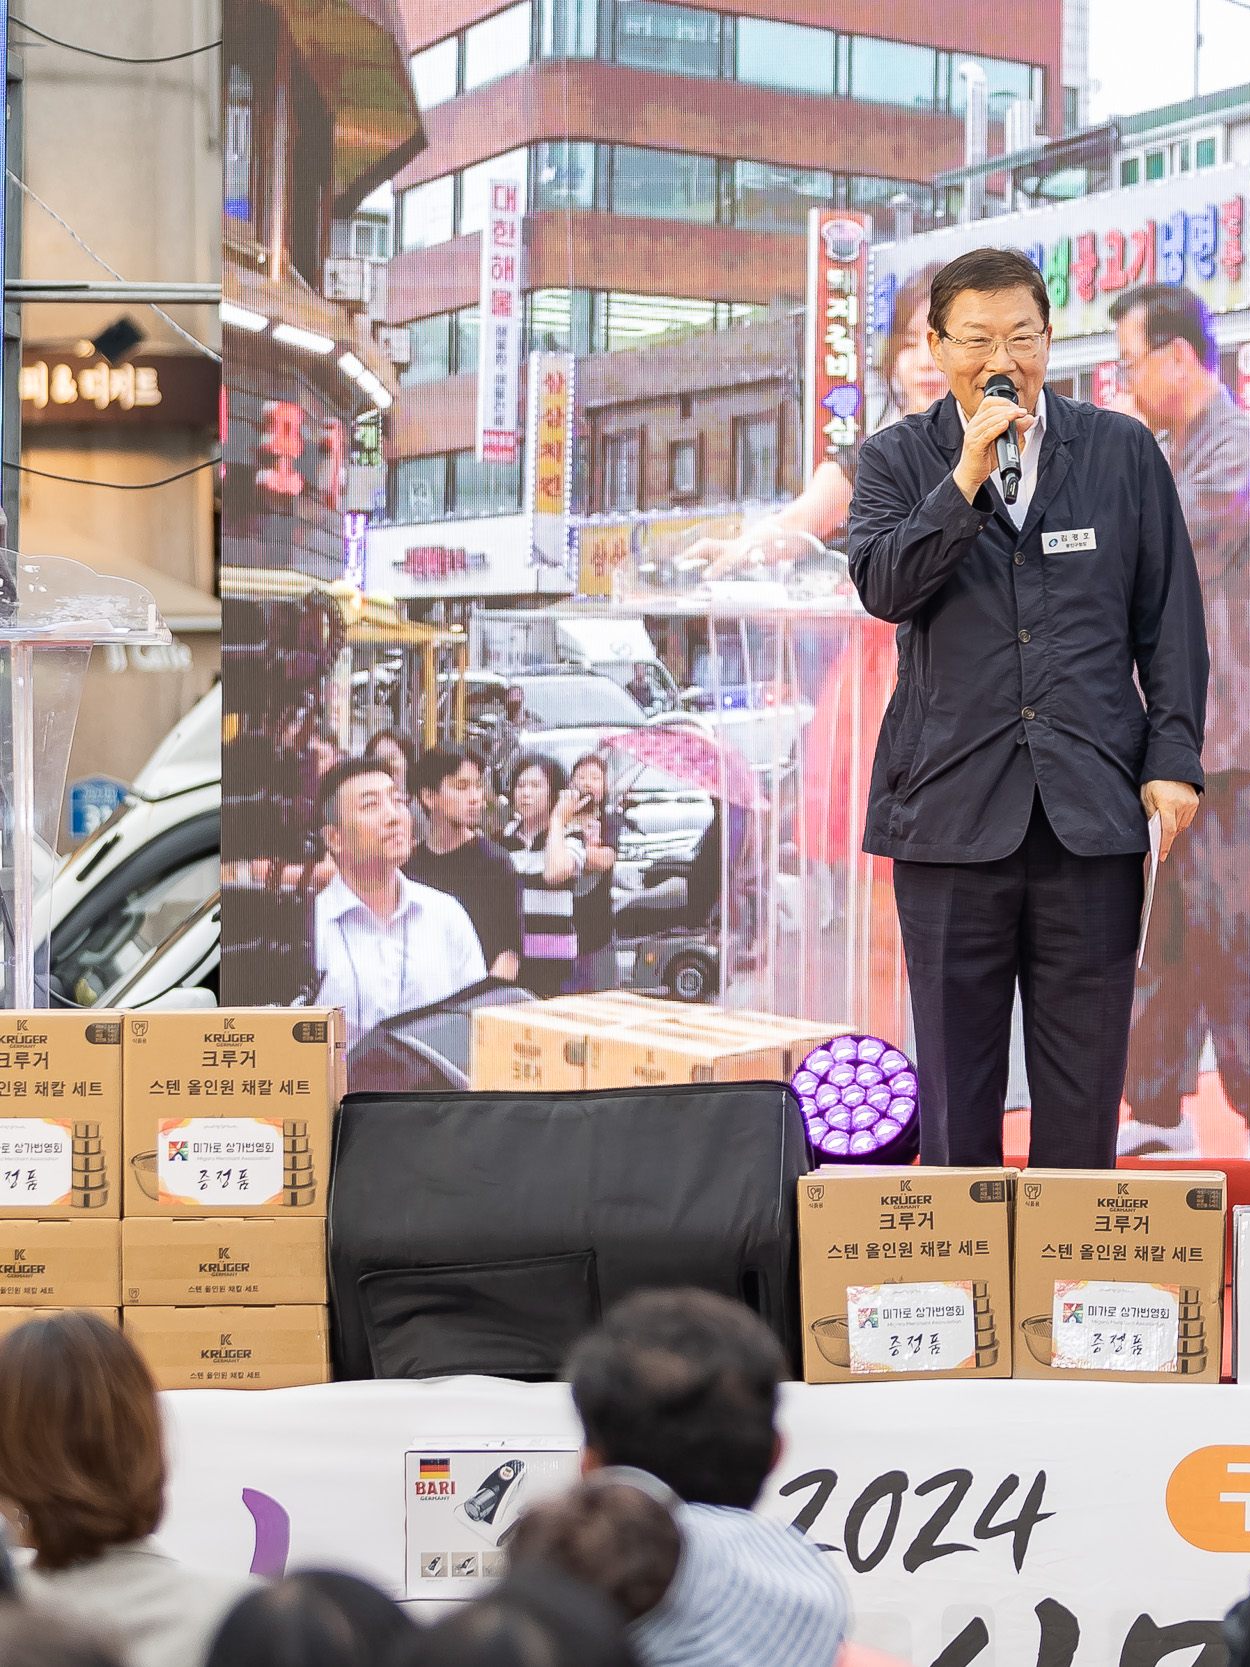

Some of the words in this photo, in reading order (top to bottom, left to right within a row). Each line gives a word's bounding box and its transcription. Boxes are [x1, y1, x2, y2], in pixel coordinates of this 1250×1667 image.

[204, 1031, 255, 1043] KRÜGER
[0, 1051, 49, 1069] 크루거
[201, 1050, 257, 1068] 크루거
[0, 1081, 28, 1097] 인원
[34, 1081, 66, 1097] 채칼
[72, 1081, 104, 1097] 세트
[149, 1079, 181, 1095] 스텐
[187, 1079, 235, 1095] 올인원
[241, 1079, 273, 1095] 채칼
[279, 1079, 311, 1095] 세트
[193, 1142, 223, 1153] 미가로
[226, 1142, 275, 1153] 상가번영회
[4, 1168, 38, 1191] 정품
[880, 1192, 933, 1205] KRÜGER
[1097, 1196, 1149, 1208] KRÜGER
[879, 1211, 935, 1231] 크루거
[1094, 1215, 1150, 1234] 크루거
[827, 1243, 859, 1259] 스텐
[865, 1242, 914, 1259] 올인원
[919, 1241, 952, 1257] 채칼
[958, 1240, 990, 1256] 세트
[1041, 1243, 1073, 1260] 스텐
[1079, 1244, 1127, 1261] 올인원
[1134, 1245, 1166, 1262] 채칼
[1172, 1246, 1204, 1262] 세트
[199, 1260, 250, 1273] KRÜGER
[883, 1307, 912, 1319] 미가로
[915, 1305, 965, 1318] 상가번영회
[1088, 1305, 1116, 1317] 미가로
[1120, 1306, 1170, 1319] 상가번영회
[200, 1347, 252, 1360] KRÜGER
[415, 1481, 456, 1495] BARI
[779, 1468, 1057, 1574] 2024
